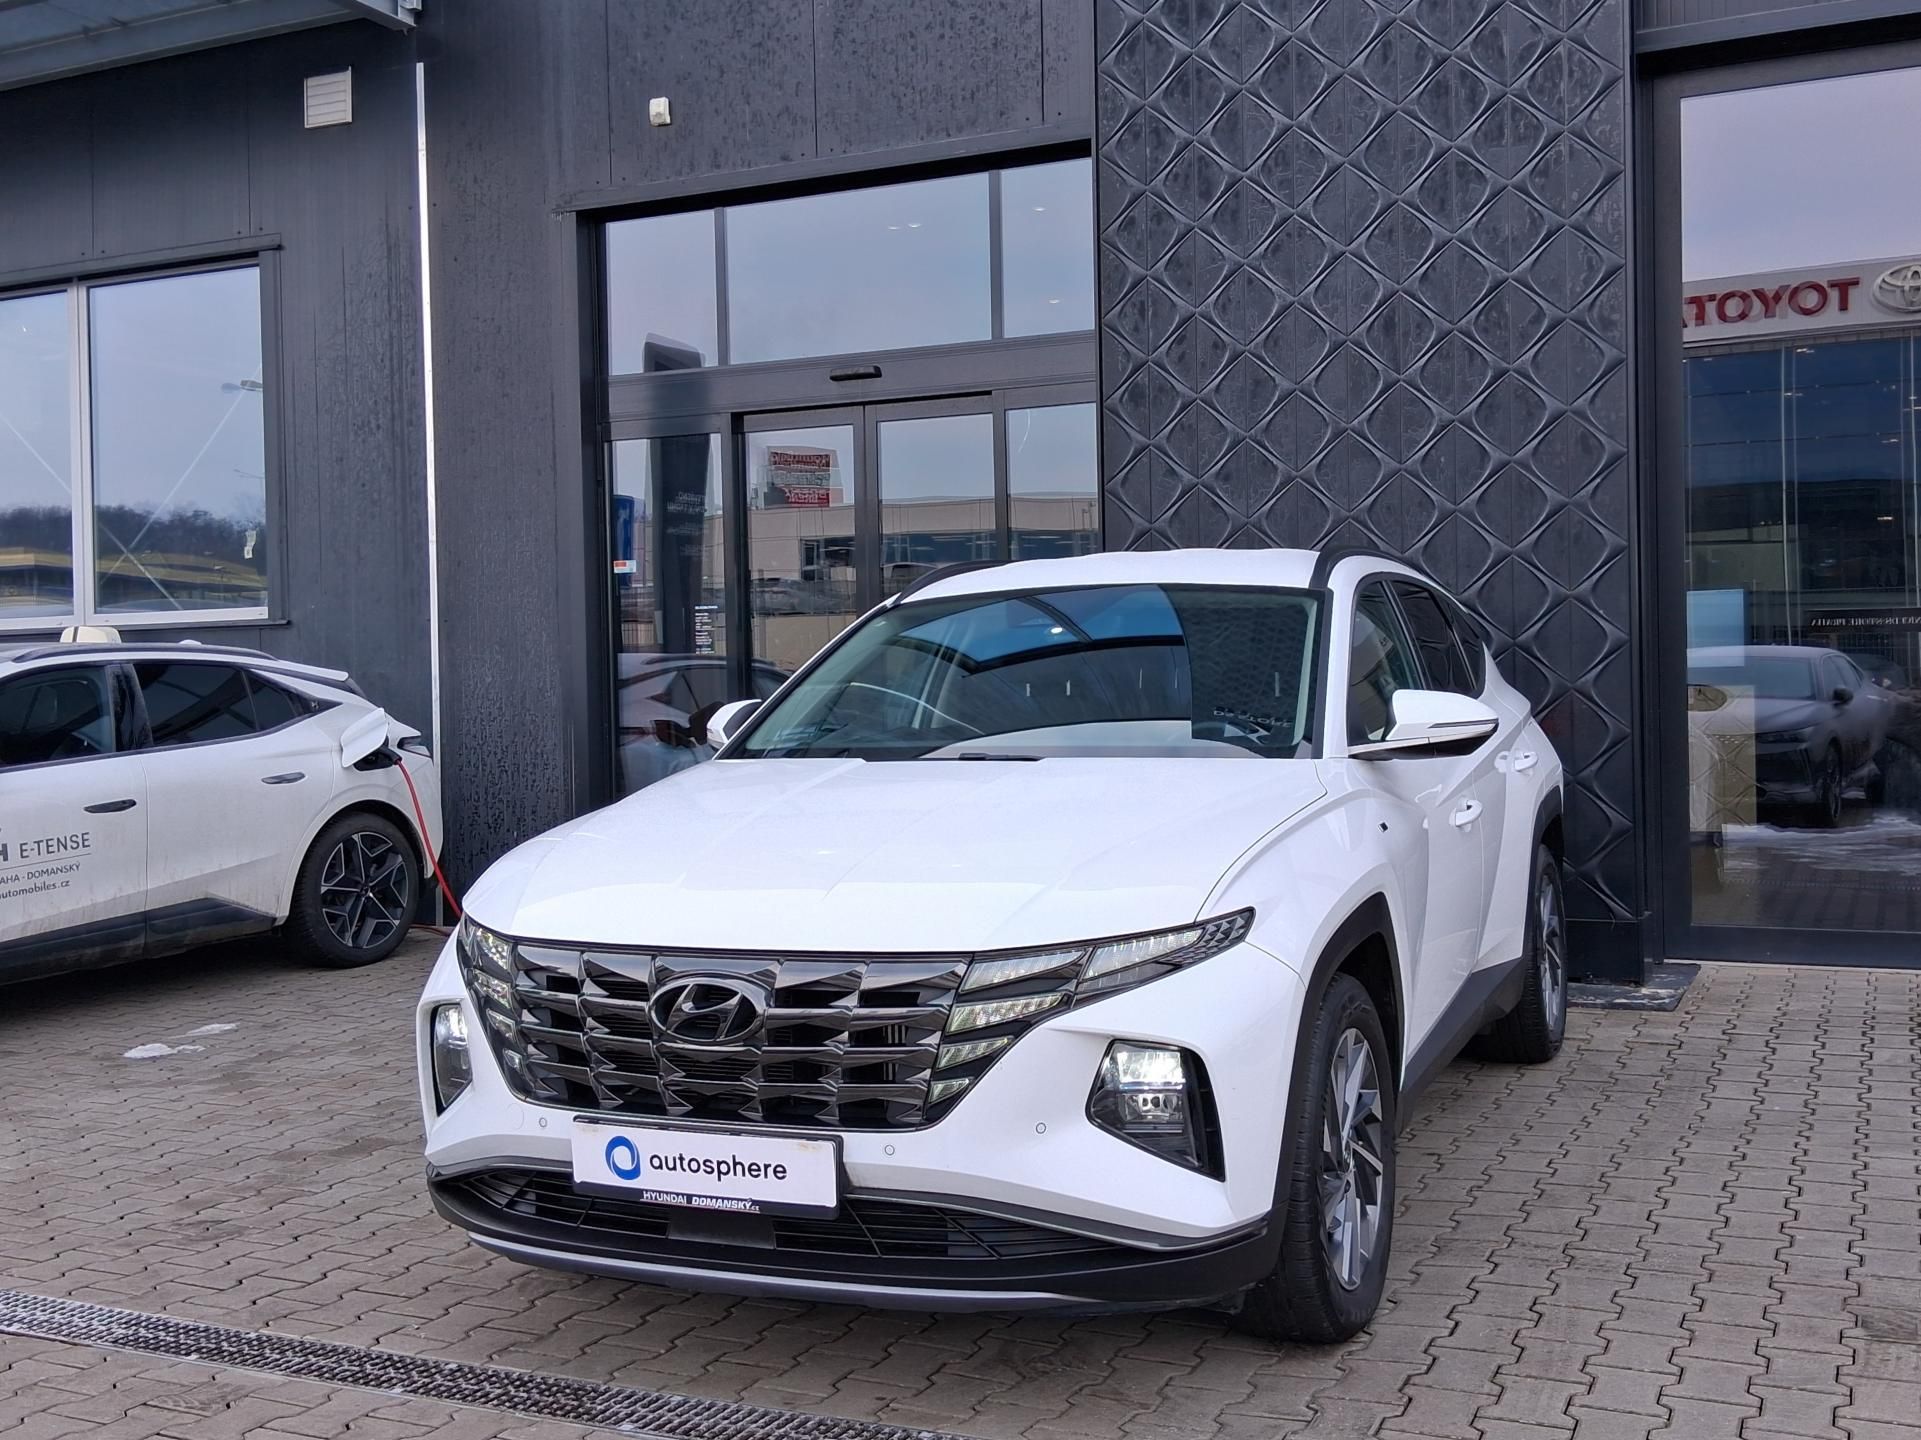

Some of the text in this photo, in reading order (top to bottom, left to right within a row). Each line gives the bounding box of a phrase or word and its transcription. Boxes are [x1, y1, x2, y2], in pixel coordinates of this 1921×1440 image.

[19, 832, 91, 859] E-TENSE
[649, 1153, 788, 1182] autosphere
[643, 1190, 687, 1205] HYUNDAI
